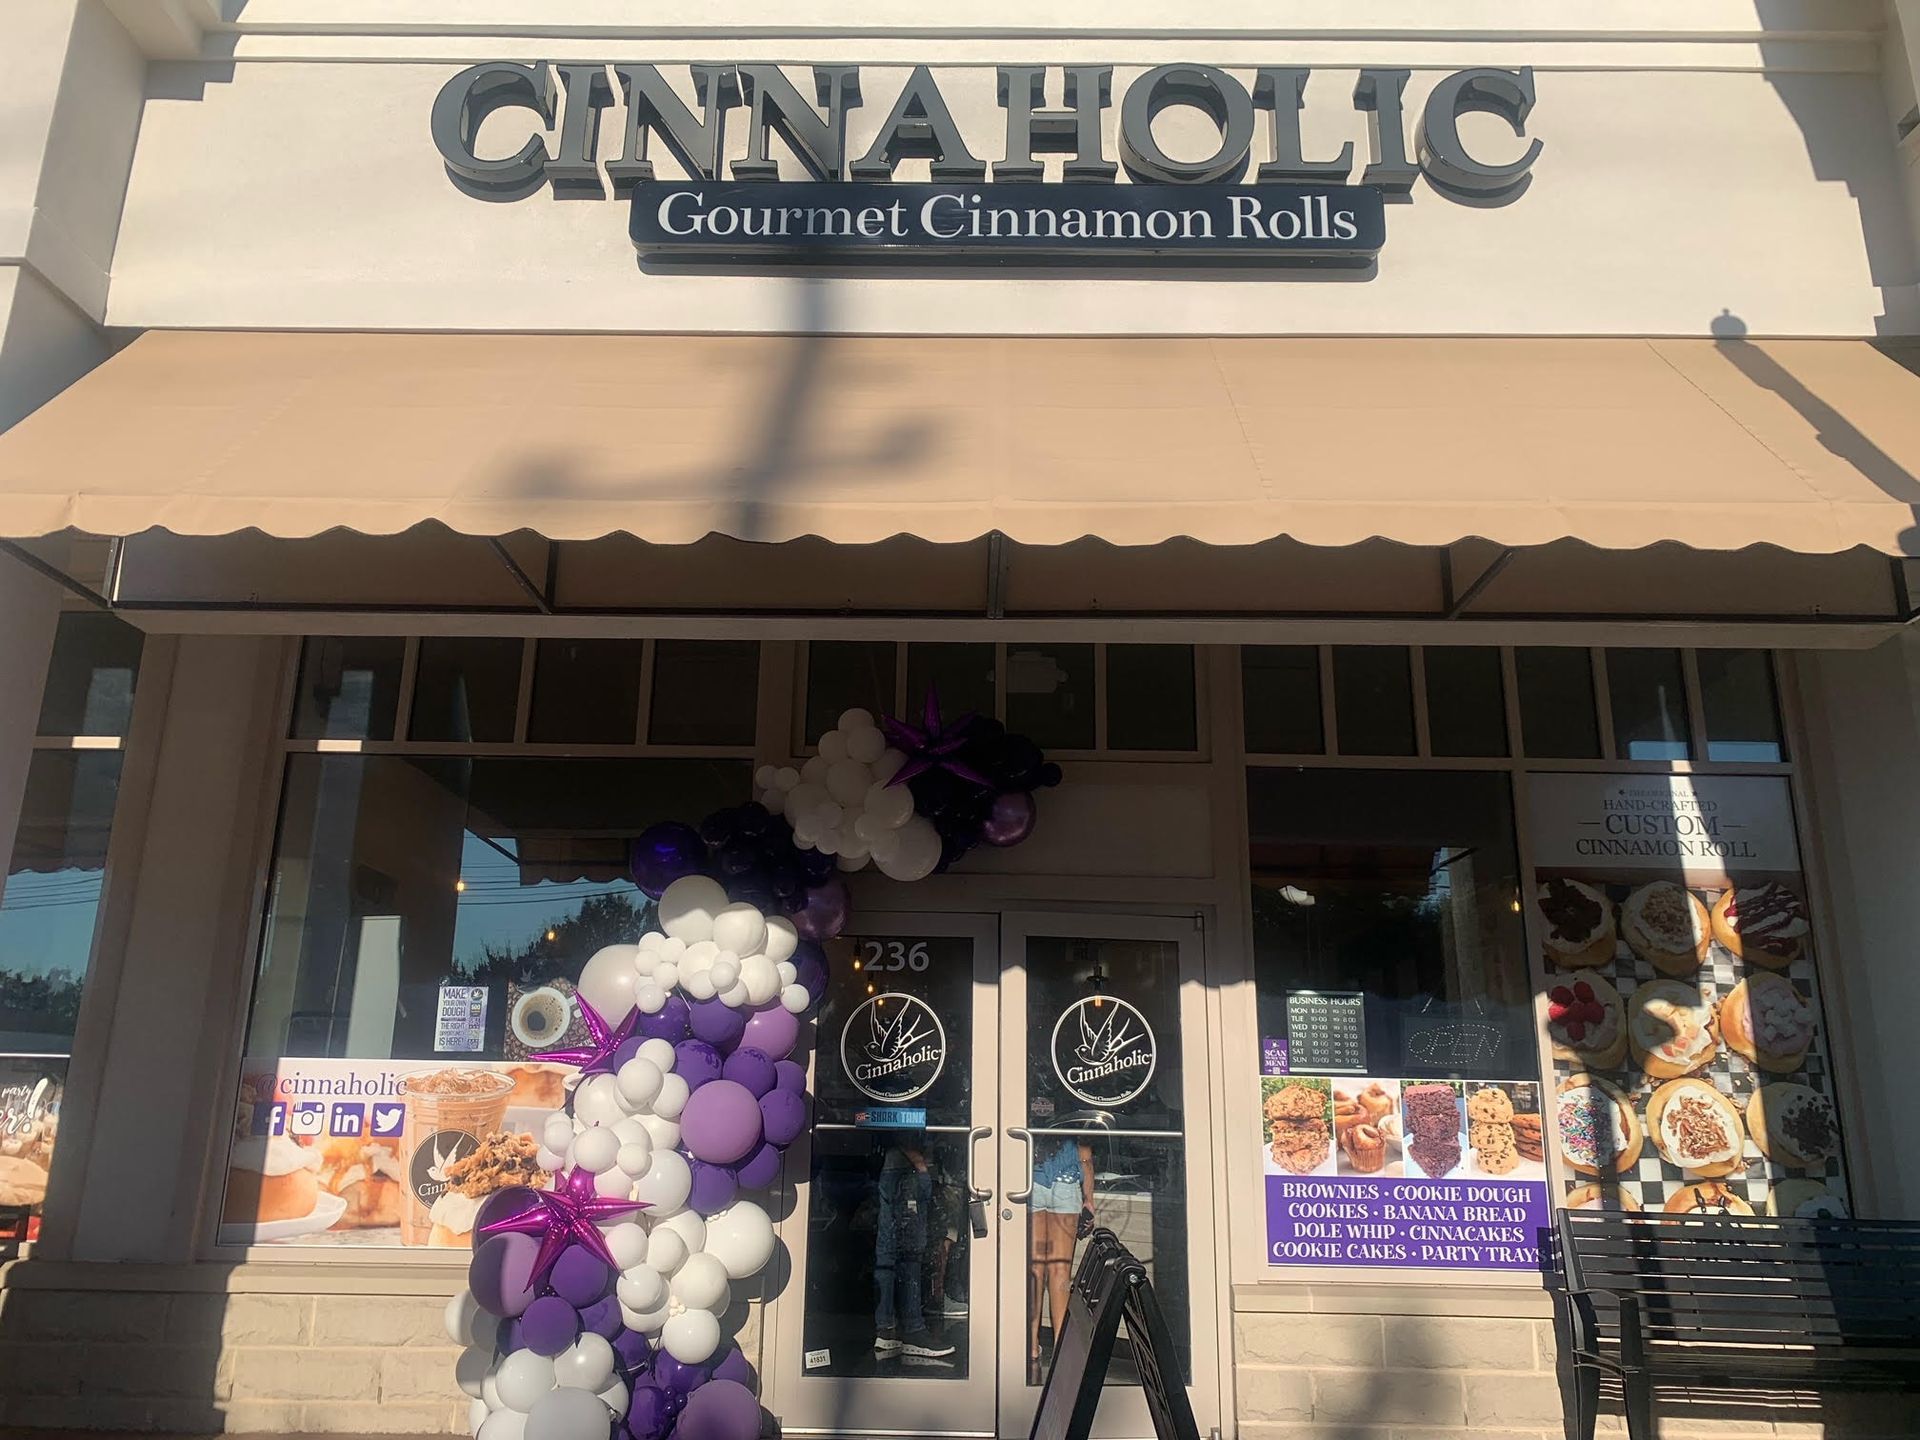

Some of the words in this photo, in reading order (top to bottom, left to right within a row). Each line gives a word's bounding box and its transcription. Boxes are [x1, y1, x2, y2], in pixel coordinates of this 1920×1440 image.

[431, 60, 1543, 193] CINNAHOLIC
[657, 192, 909, 239] Gourmet
[920, 194, 1212, 240] Cinnamon
[1227, 196, 1357, 240] Rolls
[1604, 800, 1718, 812] HAND-CRAFTED
[1606, 814, 1720, 836] CUSTOM
[1576, 838, 1694, 856] CINNAMON
[1701, 840, 1757, 858] ROLL
[863, 941, 929, 972] 236
[444, 988, 466, 999] MAKE
[1289, 996, 1328, 1005] BUSINESS
[1331, 998, 1361, 1006] HOURS
[442, 1007, 465, 1016] DOUGH
[1409, 1028, 1502, 1060] OPEN
[856, 1045, 941, 1080] Cinnaholic
[1067, 1049, 1152, 1083] Cinnaholic
[1, 1084, 32, 1103] party
[256, 1072, 408, 1096] @cinnaholic
[871, 1111, 898, 1122] SHARK
[901, 1112, 925, 1123] TANK
[1282, 1183, 1380, 1200] BROWNIES
[1393, 1185, 1462, 1201] COOKIE
[1467, 1187, 1531, 1203] DOUGH
[1288, 1202, 1369, 1219] COOKIES
[1383, 1204, 1458, 1221] BANANA
[1463, 1206, 1526, 1223] BREAD
[1293, 1222, 1343, 1238] DOLE
[1346, 1224, 1396, 1240] WHIP
[1409, 1224, 1525, 1243] CINNACAKES
[1272, 1241, 1343, 1258] COOKIE
[1346, 1243, 1407, 1260] CAKES
[1421, 1245, 1483, 1261] PARTY
[1486, 1246, 1547, 1263] TRAYS
